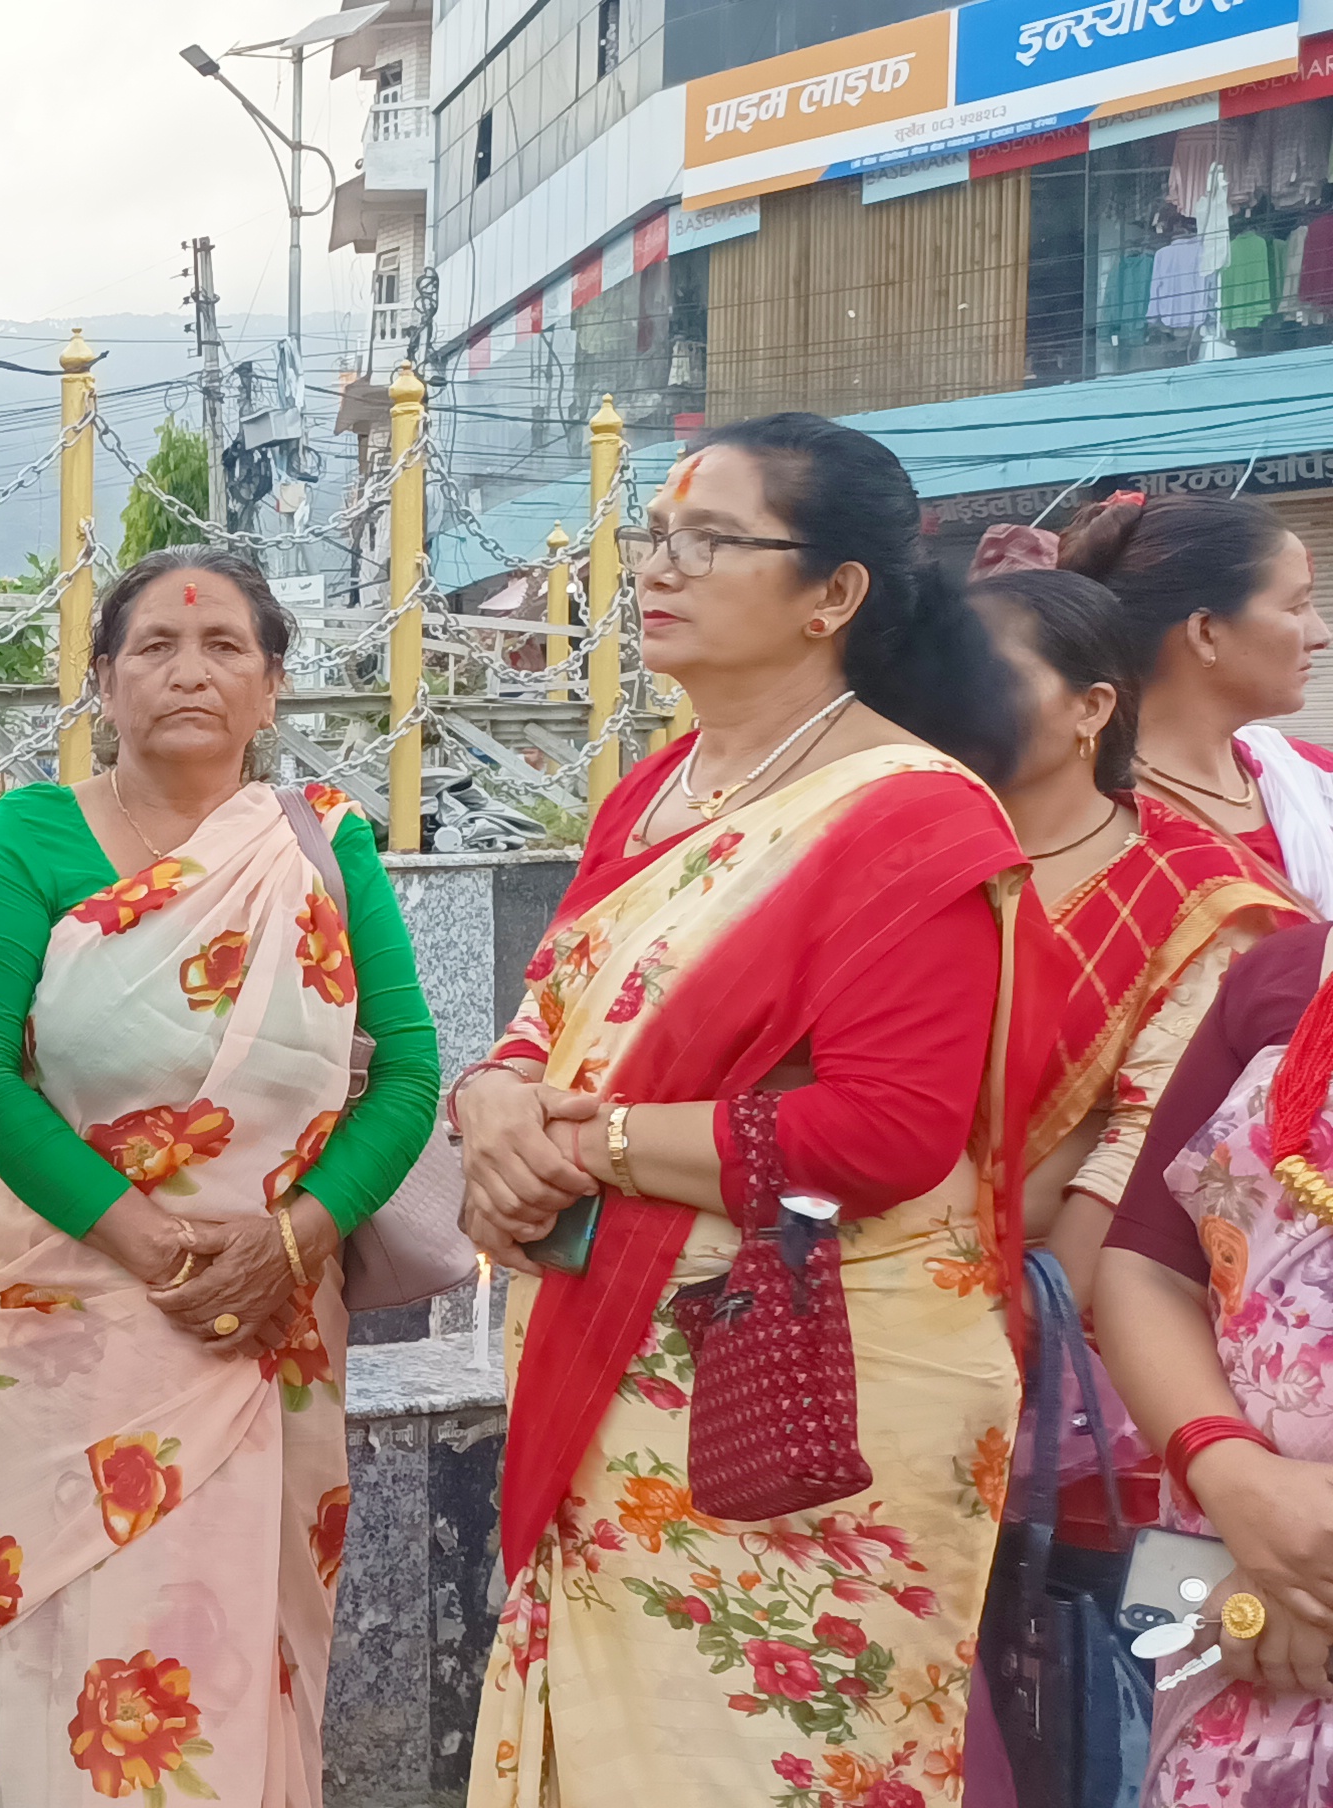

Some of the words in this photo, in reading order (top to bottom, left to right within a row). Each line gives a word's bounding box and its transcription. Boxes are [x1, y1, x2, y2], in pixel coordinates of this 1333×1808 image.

[705, 86, 790, 142] प्राइम
[791, 52, 916, 113] लाइफ
[675, 199, 758, 237] BASEMARK
